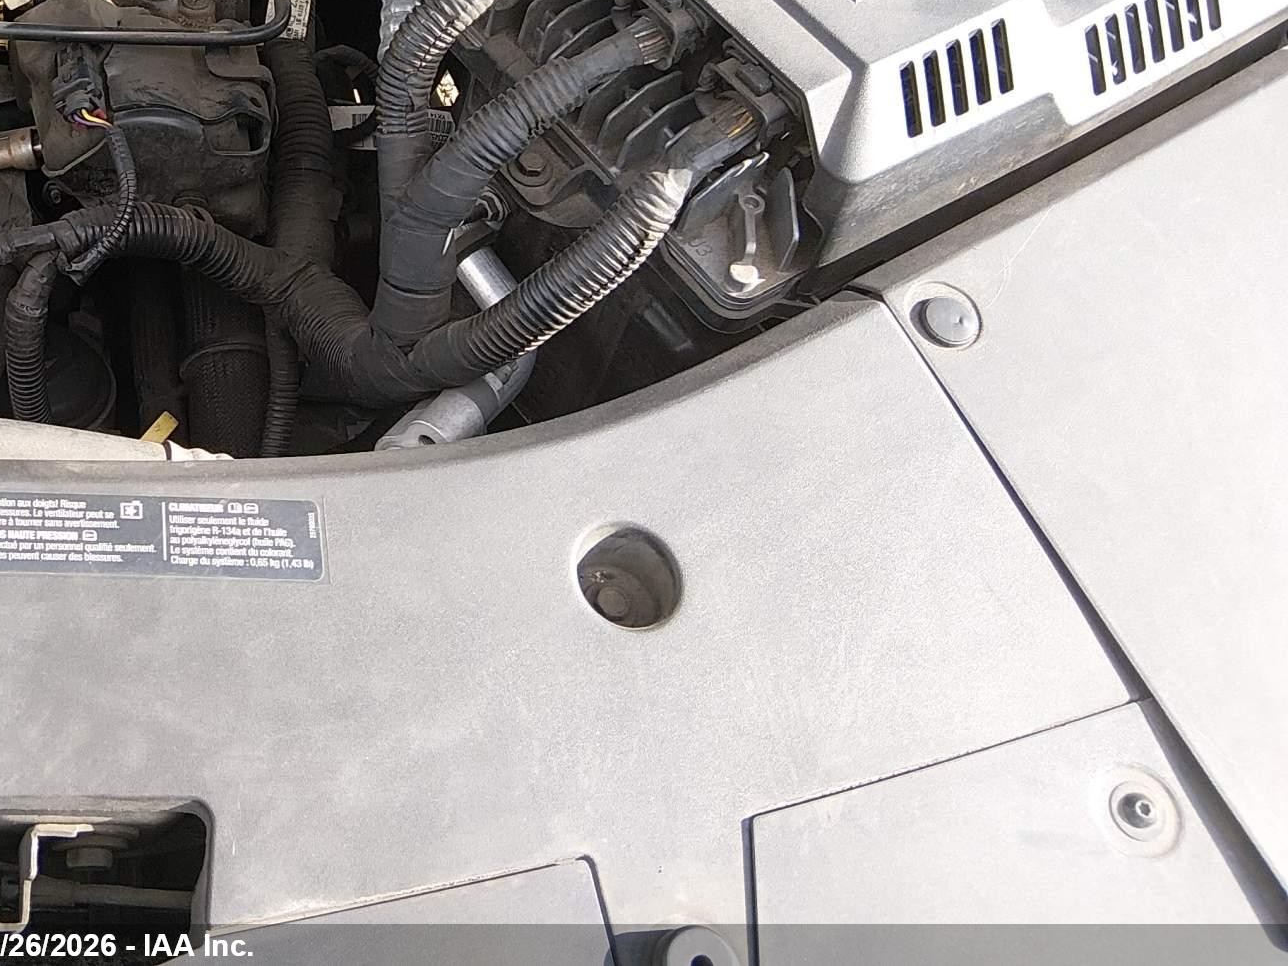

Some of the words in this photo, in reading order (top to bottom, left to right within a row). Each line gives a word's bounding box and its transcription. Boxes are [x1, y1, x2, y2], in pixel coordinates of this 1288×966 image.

[60, 500, 86, 509] Risque
[33, 509, 43, 517] Le
[44, 509, 84, 518] ventilateur
[86, 510, 103, 520] peut
[104, 511, 114, 519] se
[8, 518, 14, 526] à
[64, 520, 120, 528] avertissement.
[168, 516, 196, 524] Utiliser
[196, 516, 237, 525] seulement
[238, 517, 246, 525] le
[248, 517, 269, 526] fluide
[8, 530, 36, 539] HAUTE
[37, 530, 78, 540] PRESSION
[212, 526, 242, 536] R-134a
[243, 528, 250, 536] et
[252, 528, 262, 536] de
[19, 542, 32, 551] par
[46, 542, 83, 552] personnel
[84, 542, 112, 552] qualifié
[114, 543, 157, 552] seulement.
[252, 538, 274, 547] (huile
[274, 538, 296, 548] PAG).
[170, 546, 180, 554] Le
[182, 546, 214, 556] système
[216, 547, 246, 556] contient
[248, 548, 258, 556] du
[260, 548, 294, 557] colorant.
[9, 552, 40, 560] peuvent
[68, 553, 83, 561] des
[84, 553, 122, 562] blessures.
[170, 556, 198, 566] Charge
[200, 557, 210, 566] du
[212, 557, 244, 567] système
[250, 558, 268, 568] 0,65
[270, 559, 280, 569] kg
[304, 559, 314, 570] lb)
